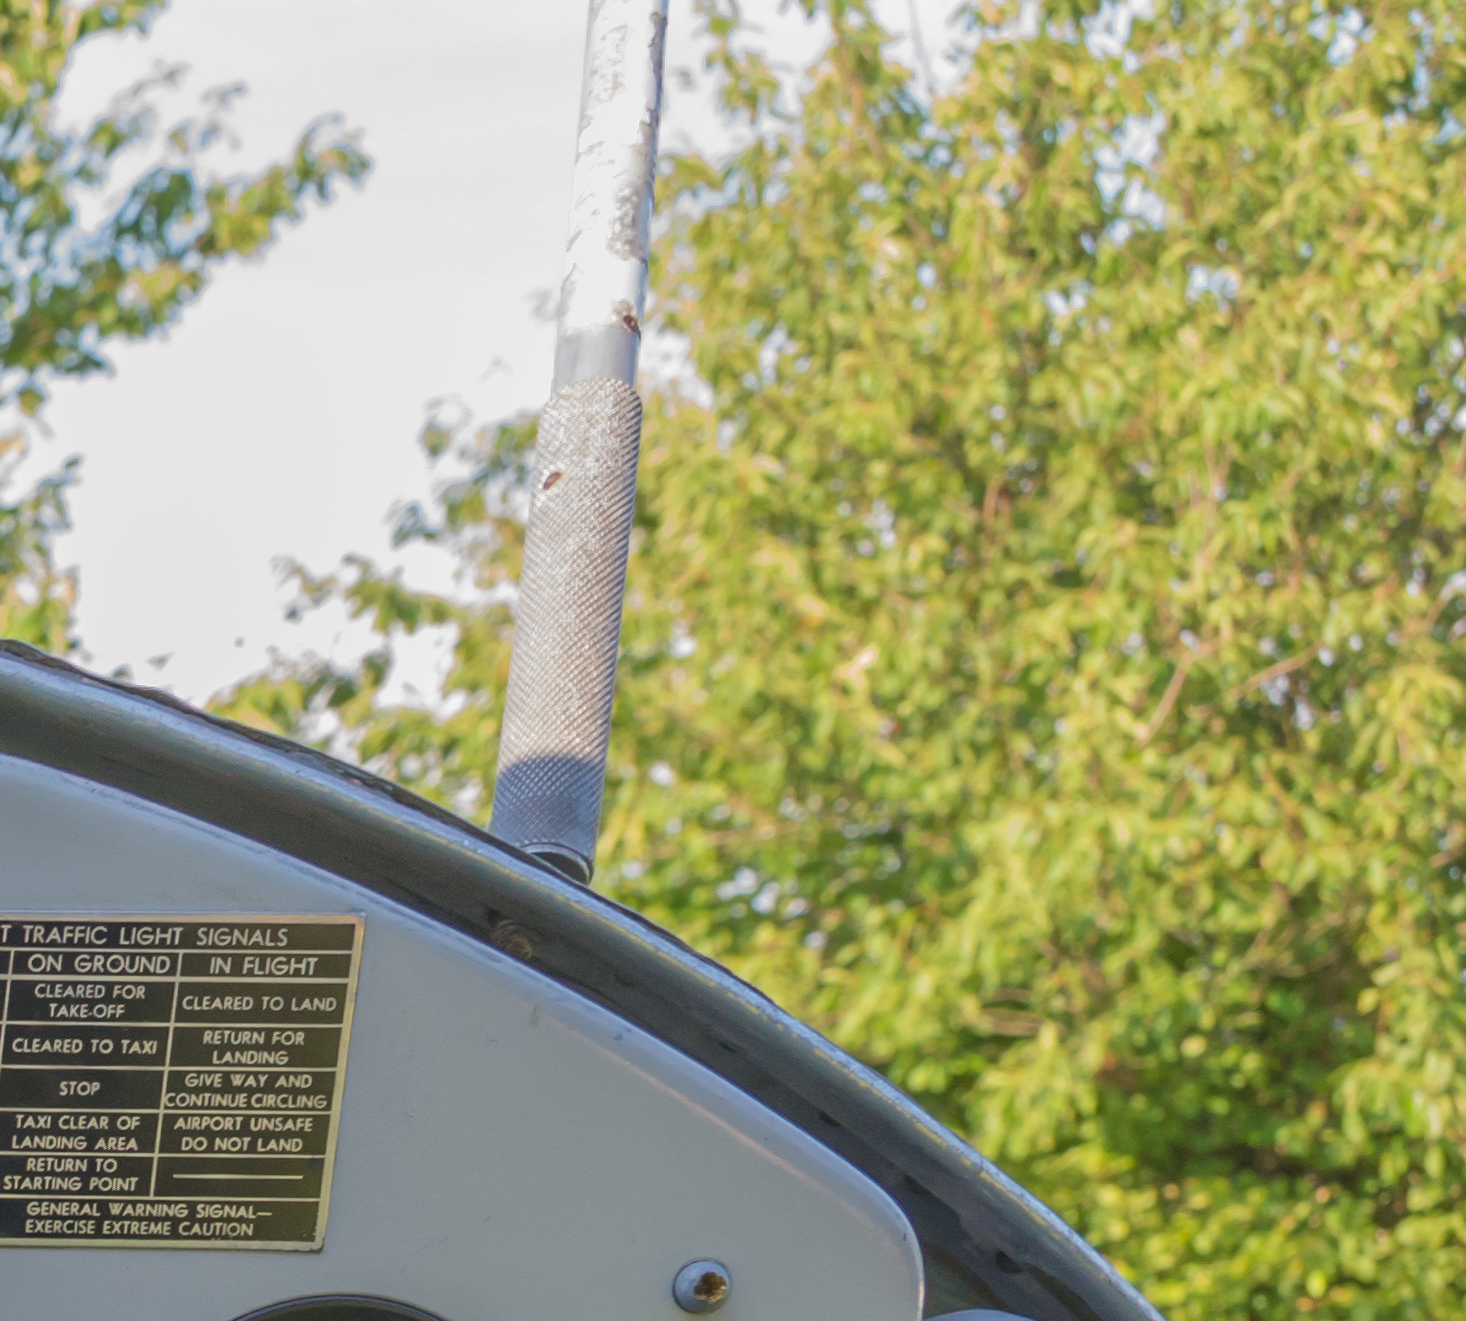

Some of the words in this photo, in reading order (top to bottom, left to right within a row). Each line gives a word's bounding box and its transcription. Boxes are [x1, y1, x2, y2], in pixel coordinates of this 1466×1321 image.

[22, 925, 107, 945] TRAFFIC
[119, 926, 182, 945] LIGHT
[197, 927, 288, 947] SIGNALS
[28, 954, 62, 972] ON
[74, 954, 171, 974] GROUND
[209, 957, 232, 975] IN
[242, 956, 318, 976] FLIGHT
[34, 983, 105, 999] CLEARED
[112, 983, 146, 999] FOR
[48, 1002, 126, 1019] TAKE-OFF
[182, 995, 253, 1011] CLEARED
[262, 996, 284, 1012] TO
[292, 996, 337, 1012] LAND
[59, 1080, 100, 1096] STOP
